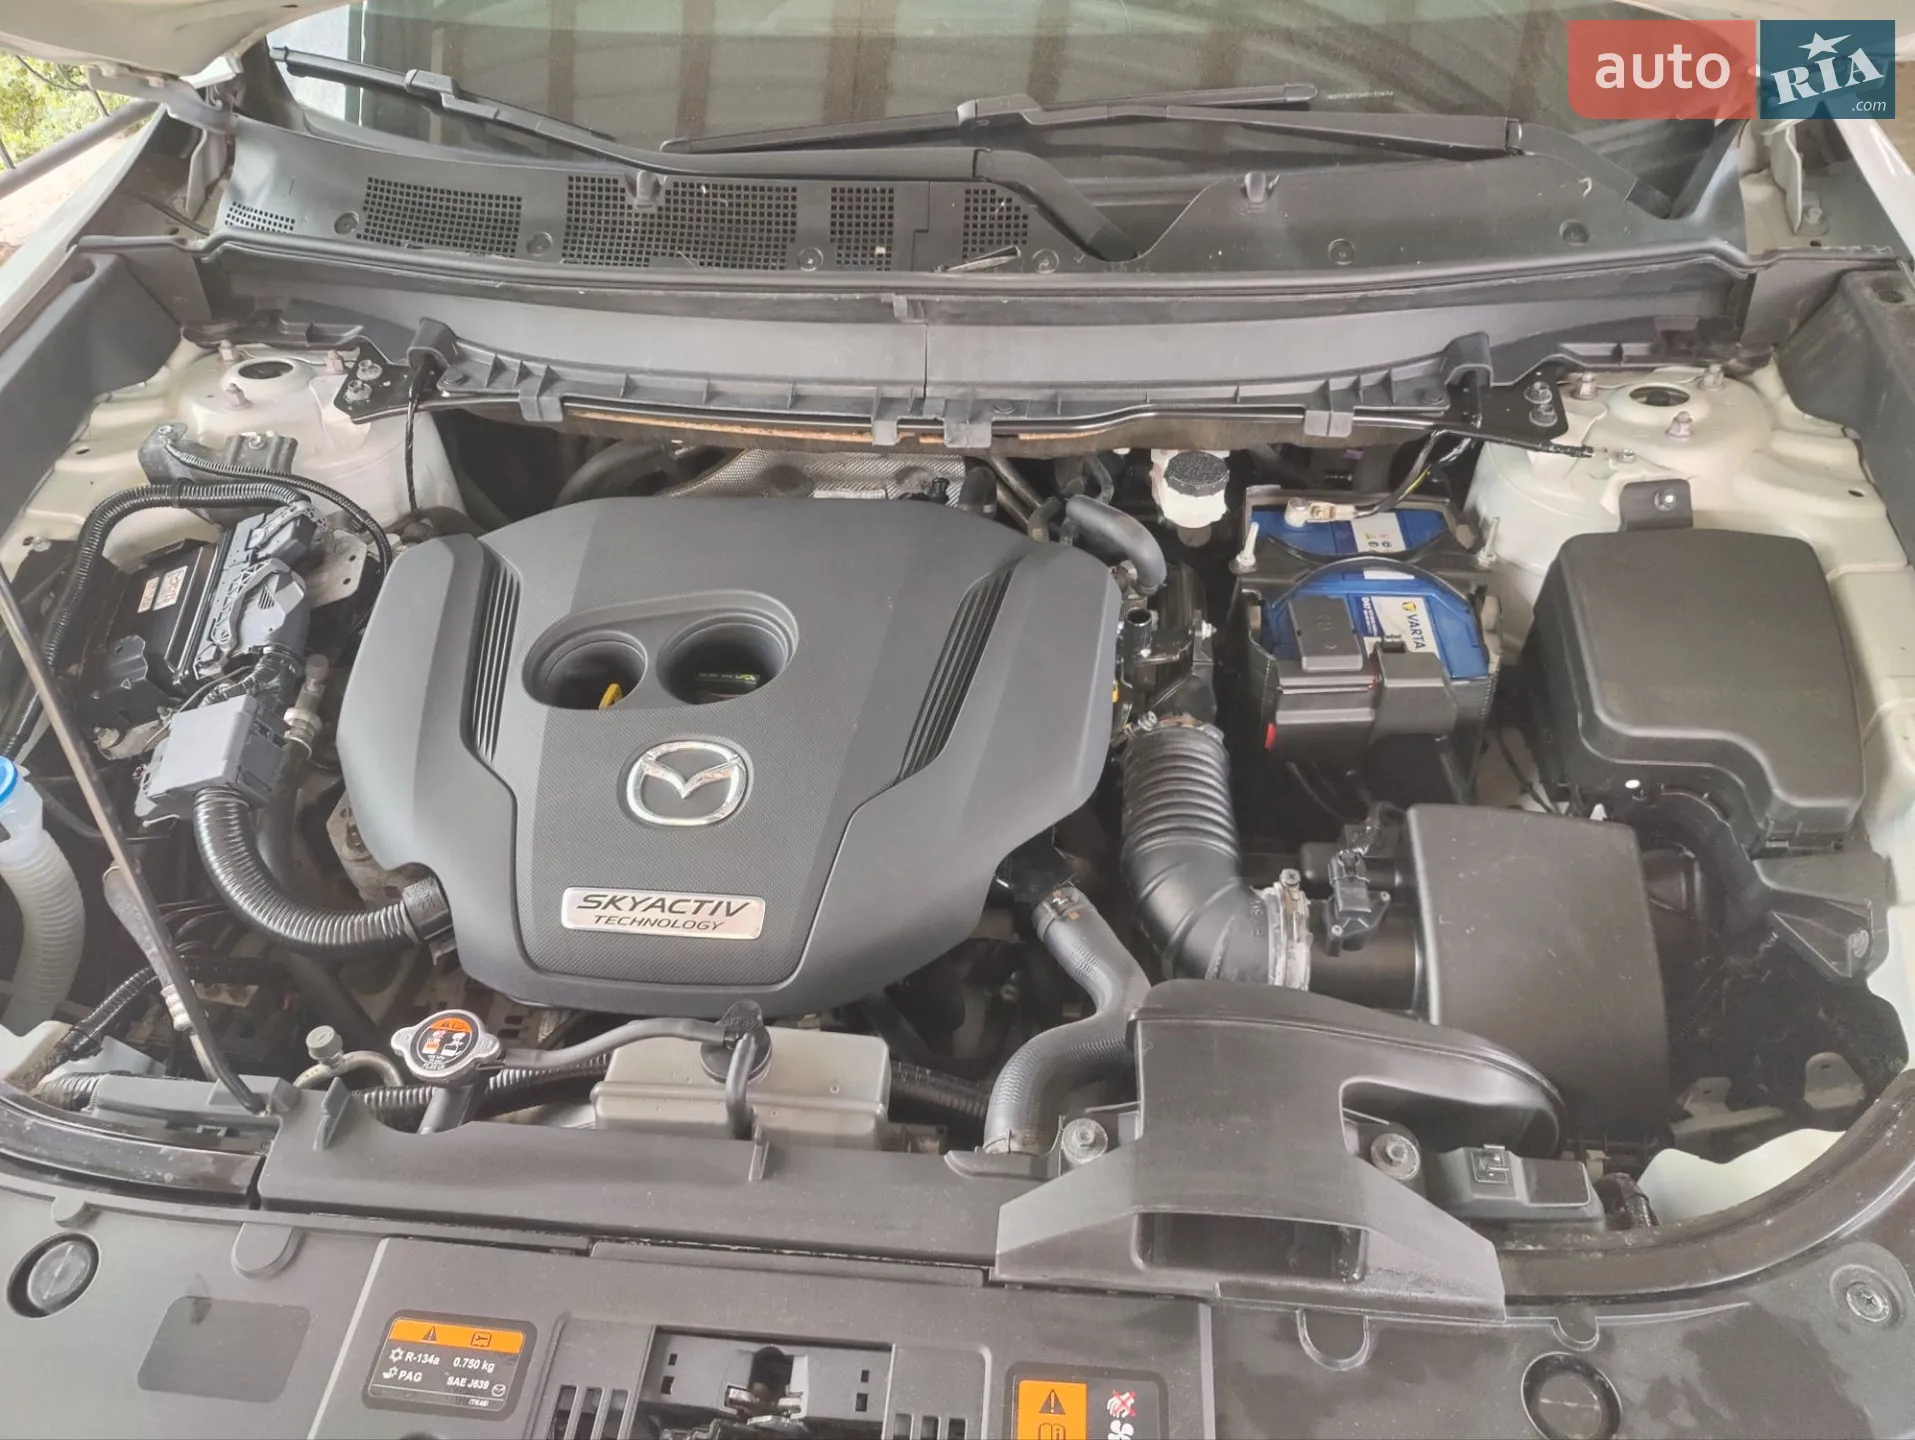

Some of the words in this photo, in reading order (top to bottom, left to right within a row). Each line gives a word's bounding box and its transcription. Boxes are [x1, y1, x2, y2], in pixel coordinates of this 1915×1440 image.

[1407, 614, 1426, 649] VARTA
[576, 894, 750, 917] SKYACTIV
[594, 915, 724, 931] TECHNOLOGY
[405, 1352, 440, 1365] R-134a
[453, 1357, 480, 1369] 0.750
[481, 1360, 495, 1373] kg
[398, 1371, 423, 1382] PAG
[446, 1376, 467, 1388] SAE
[467, 1379, 490, 1390] J639
